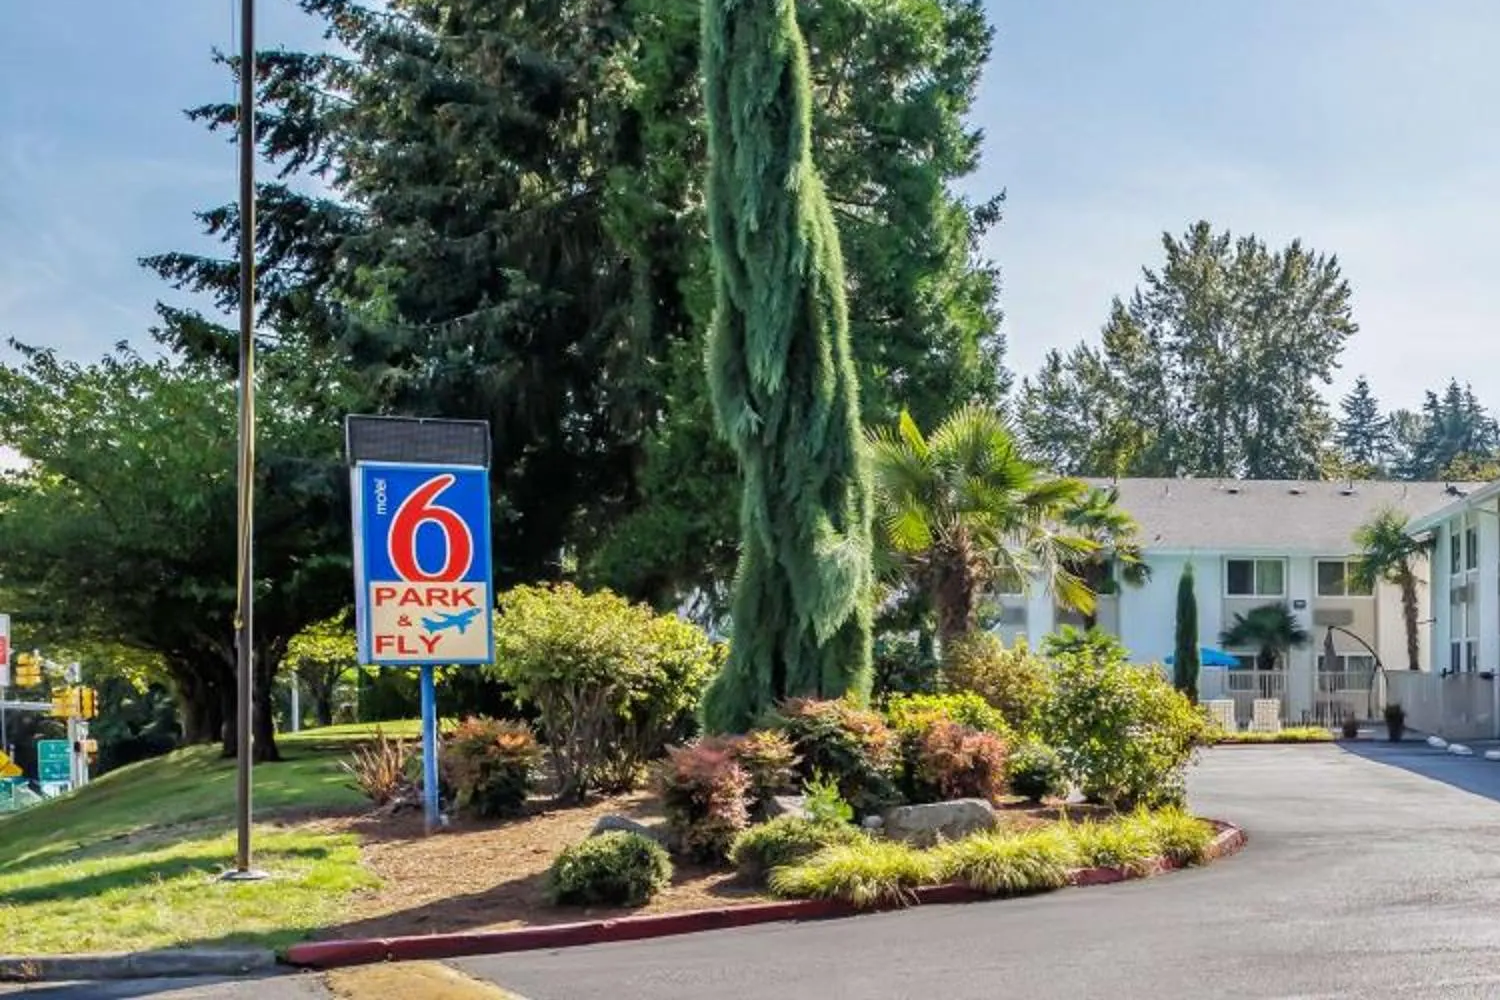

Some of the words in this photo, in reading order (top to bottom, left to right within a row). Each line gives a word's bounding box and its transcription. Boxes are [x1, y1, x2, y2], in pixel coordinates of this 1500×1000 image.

[387, 473, 474, 583] 6
[374, 587, 476, 608] PARK
[397, 615, 412, 627] &
[374, 634, 444, 655] FLY
